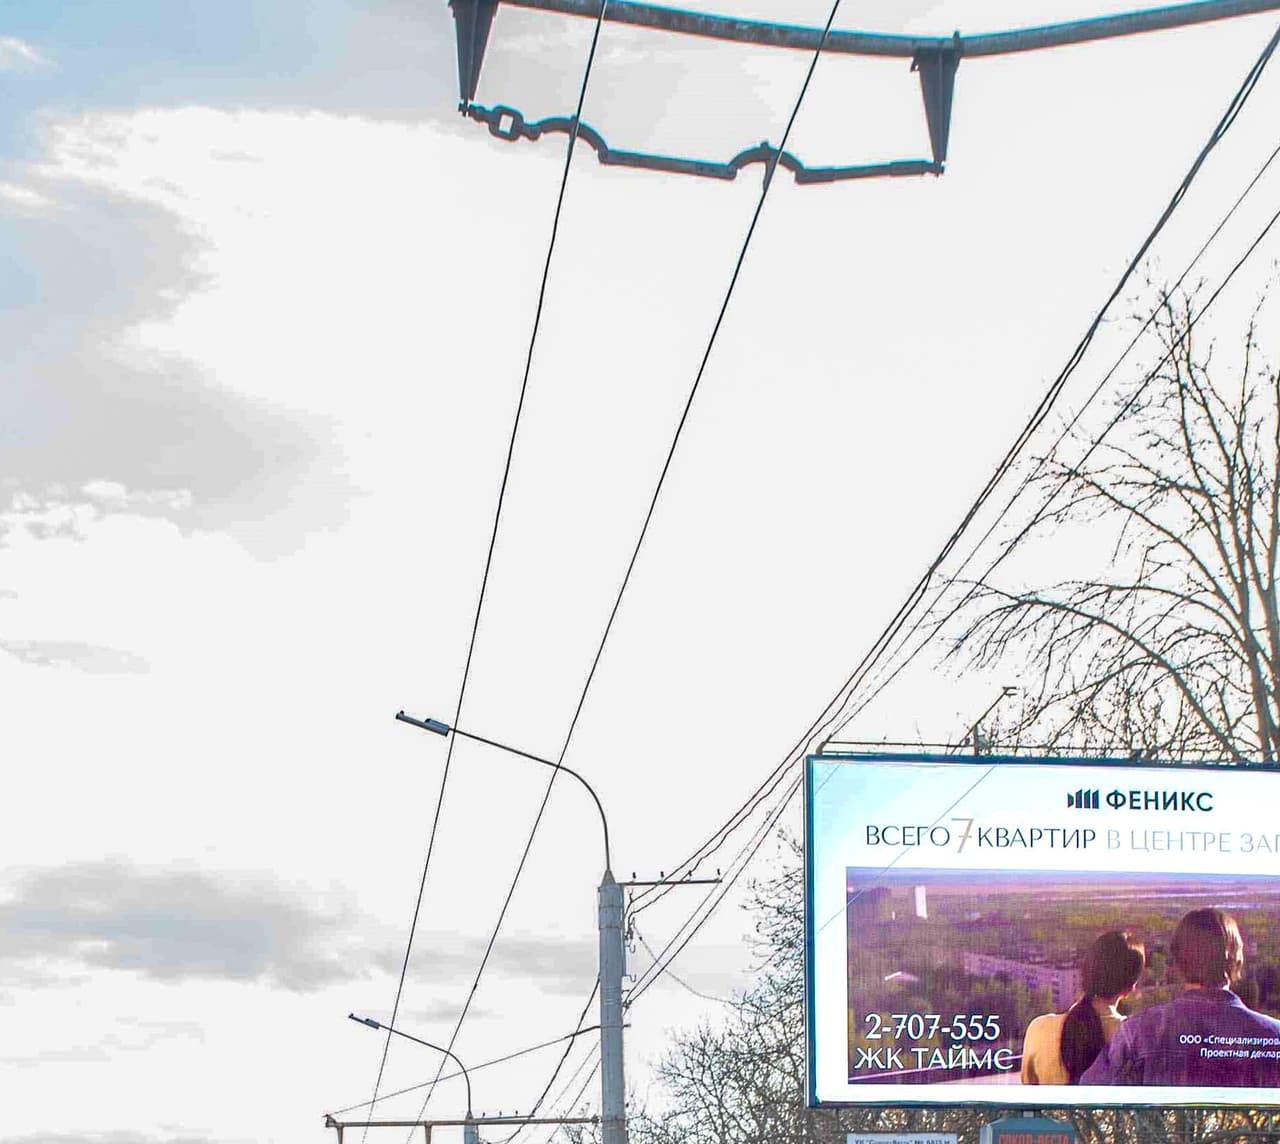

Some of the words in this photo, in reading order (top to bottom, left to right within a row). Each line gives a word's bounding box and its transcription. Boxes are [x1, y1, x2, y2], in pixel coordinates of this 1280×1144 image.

[1106, 790, 1214, 812] ФЕНИКС
[866, 825, 951, 847] ВСЕГО
[951, 818, 974, 854] 7
[978, 826, 1096, 849] КВАРТИР
[1107, 829, 1121, 850] В
[1130, 830, 1231, 853] ЦЕНТРЕ
[865, 1013, 1001, 1041] 2-707-555
[1179, 1034, 1202, 1044] ООО
[854, 1047, 903, 1069] ЖК
[911, 1044, 1014, 1070] ТАЙМС
[1200, 1048, 1249, 1058] Проектная
